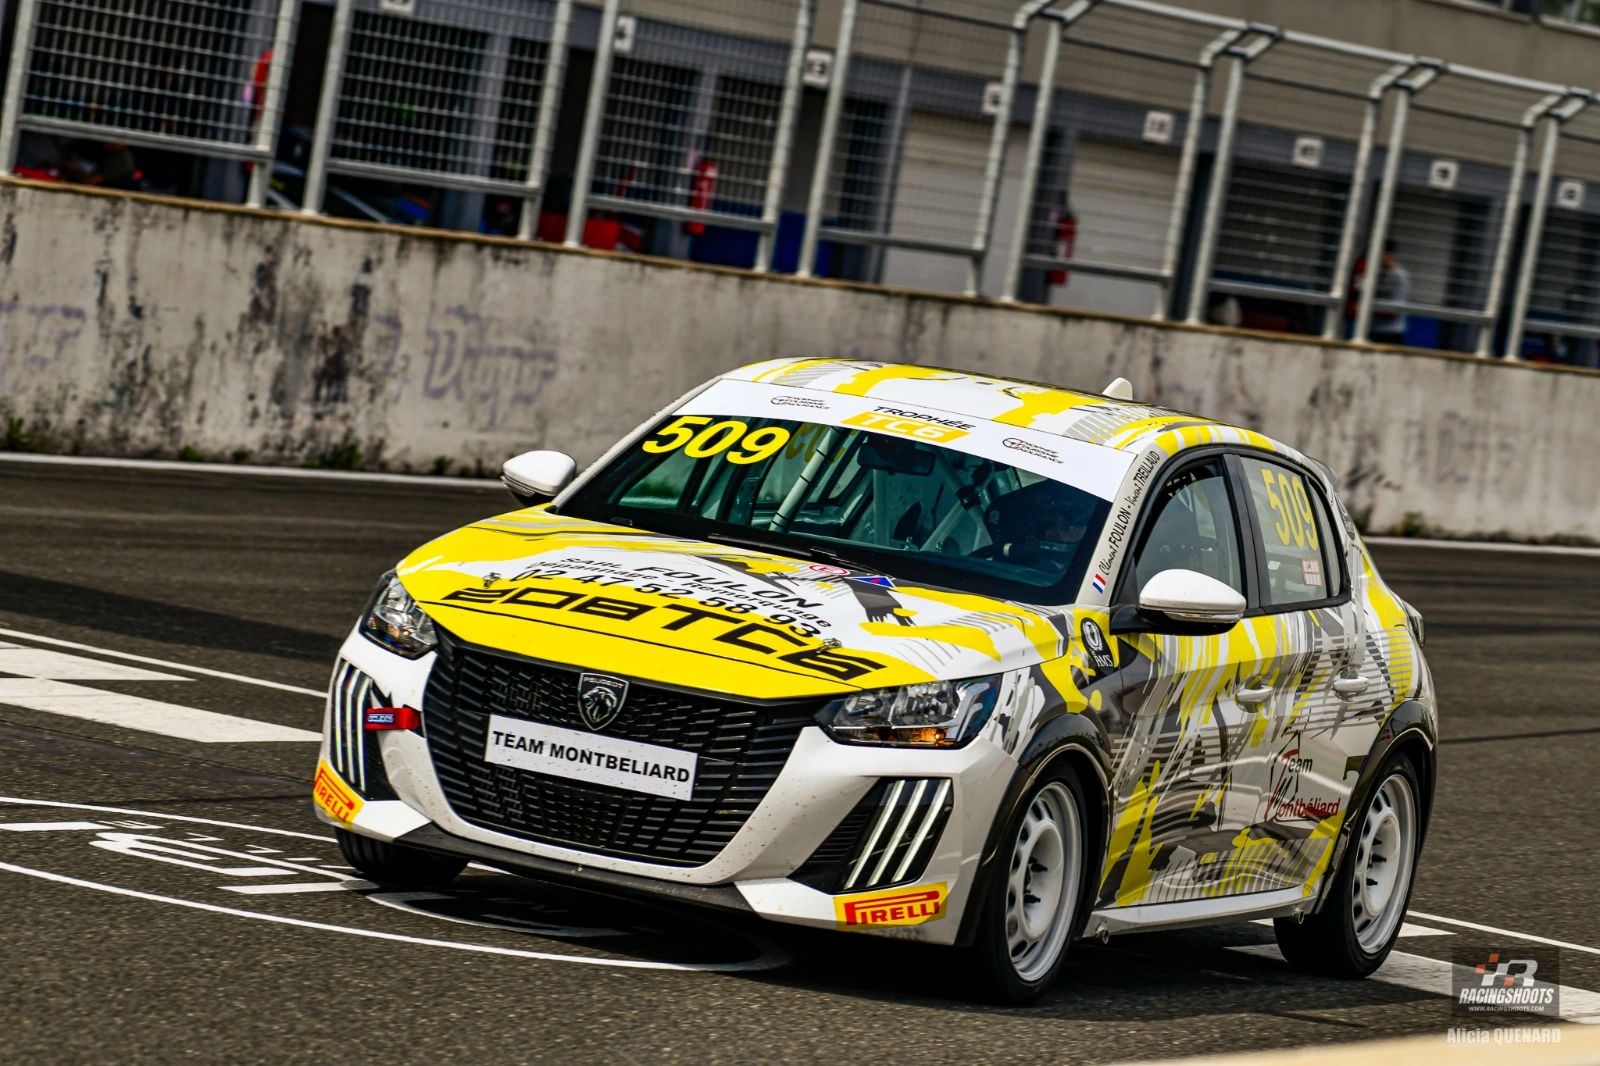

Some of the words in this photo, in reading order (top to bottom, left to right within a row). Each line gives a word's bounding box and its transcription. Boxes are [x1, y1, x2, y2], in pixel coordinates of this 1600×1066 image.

[860, 414, 953, 439] TC6
[873, 406, 976, 430] TROPHÉE
[642, 416, 790, 464] 509
[1133, 450, 1160, 487] TREILLAUD
[1108, 507, 1132, 548] FOULON
[1261, 468, 1319, 551] 509
[1099, 545, 1118, 576] Clément
[510, 569, 567, 582] 02
[573, 574, 634, 587] 47
[634, 583, 694, 599] 52
[699, 596, 759, 614] 58
[764, 614, 821, 638] 93
[561, 558, 622, 569] SARL
[634, 566, 824, 609] FOULON
[682, 582, 832, 628] Remorquage
[584, 676, 625, 689] PEUGEOT
[493, 731, 544, 755] TEAM
[549, 745, 690, 783] MONTBELIARD
[314, 768, 355, 822] PIRELLI
[844, 890, 940, 925] PIRELLI
